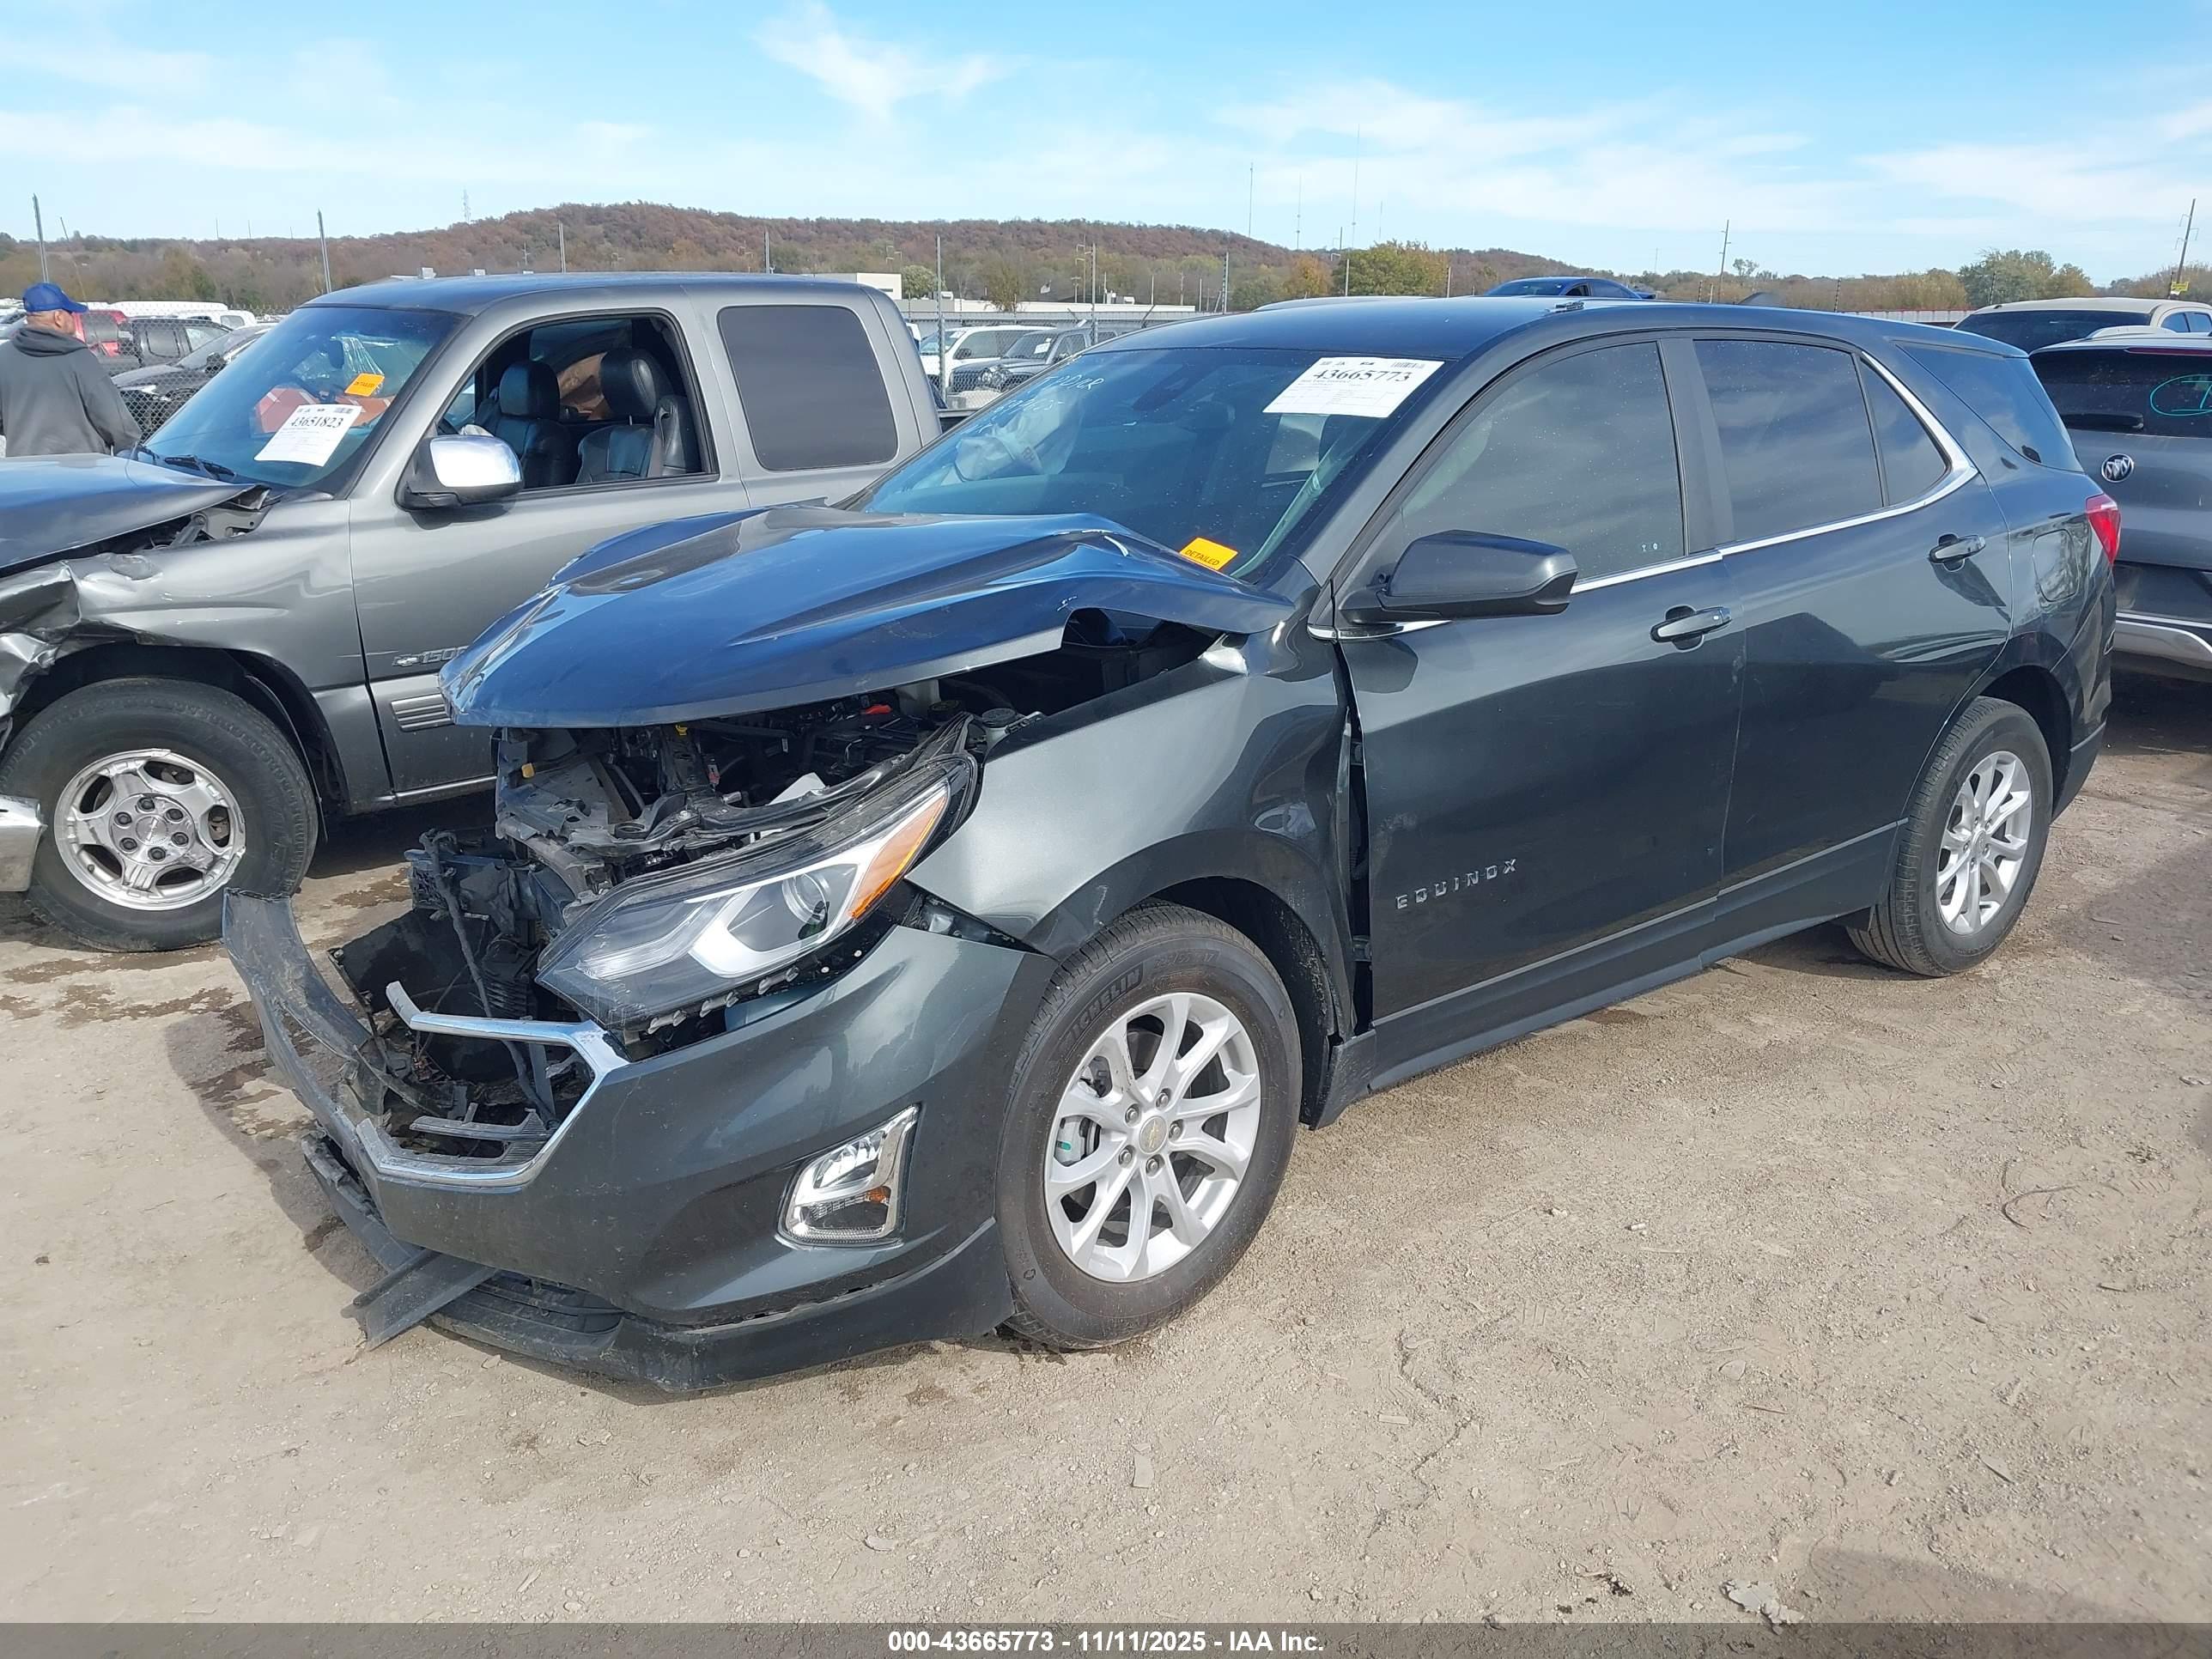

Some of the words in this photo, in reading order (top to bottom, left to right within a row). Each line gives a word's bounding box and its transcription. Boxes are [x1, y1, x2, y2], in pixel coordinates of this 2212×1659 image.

[1313, 368, 1413, 382] 43665773
[290, 416, 343, 428] 43651823
[1185, 550, 1220, 566] DETAILED
[1395, 858, 1517, 909] EQUINOX
